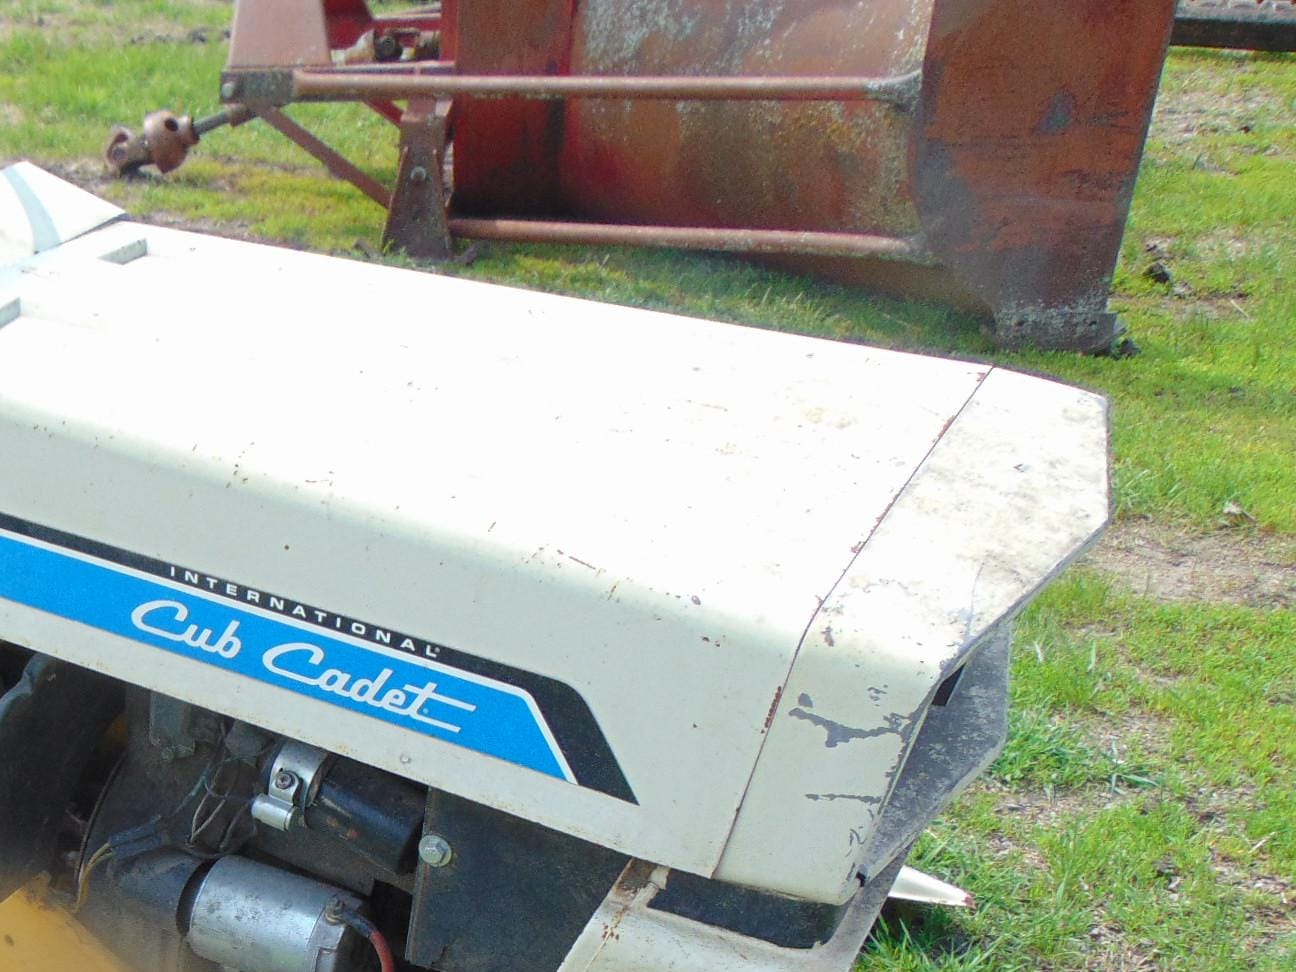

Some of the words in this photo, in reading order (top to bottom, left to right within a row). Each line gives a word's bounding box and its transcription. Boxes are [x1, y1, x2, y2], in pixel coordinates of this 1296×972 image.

[131, 600, 242, 658] Cub
[262, 642, 476, 733] Cadet
[169, 566, 438, 658] INTERNATIONAL
